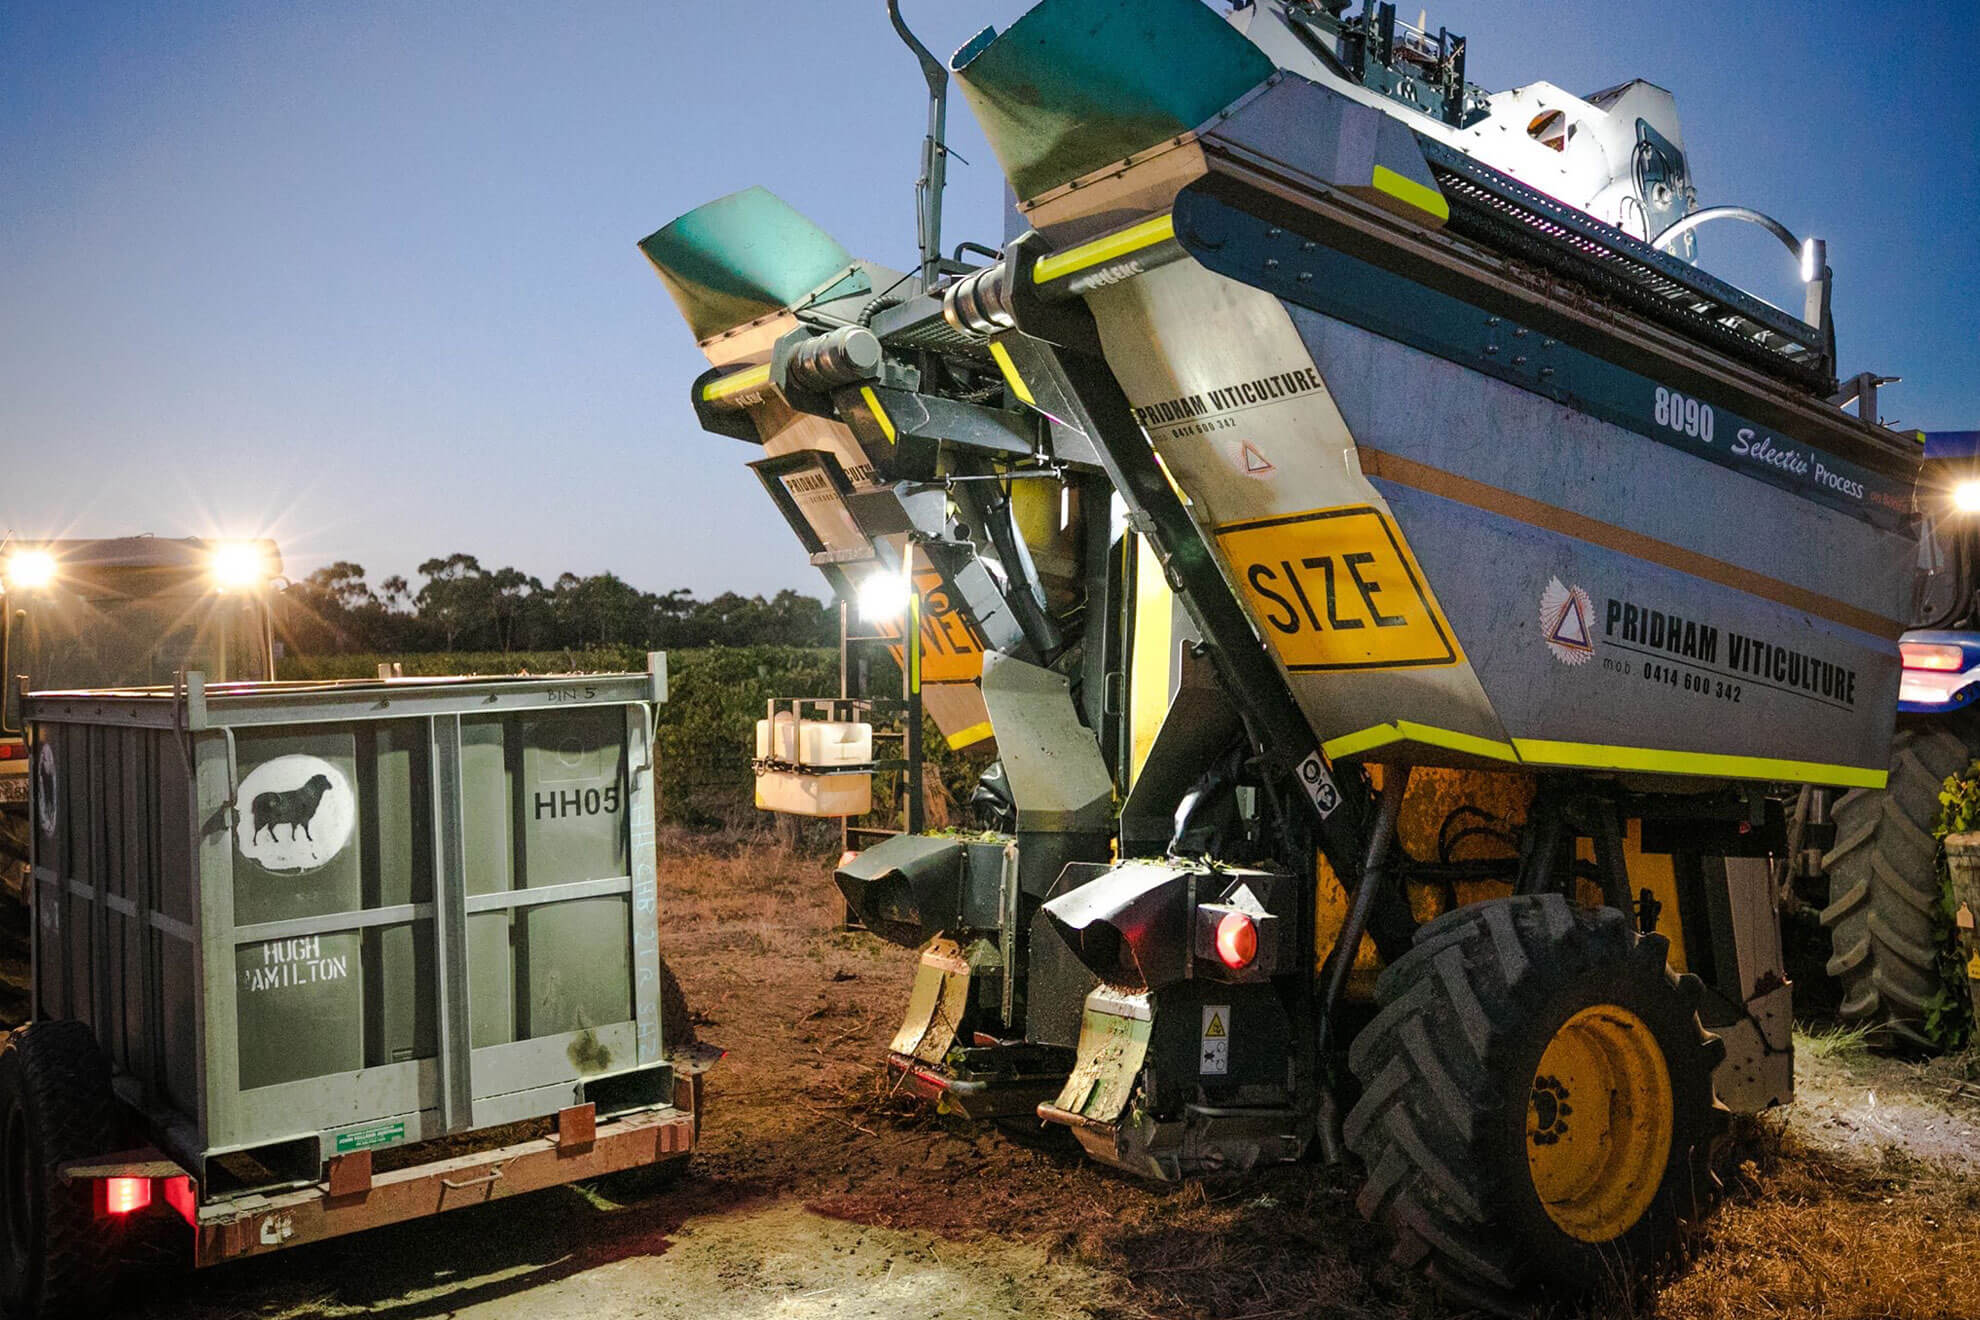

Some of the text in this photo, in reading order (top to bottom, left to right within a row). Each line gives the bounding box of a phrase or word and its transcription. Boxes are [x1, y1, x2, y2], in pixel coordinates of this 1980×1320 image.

[1137, 367, 1321, 426] PRIDHAM VITICULTURE
[1171, 428, 1195, 439] 0414
[1197, 422, 1216, 435] 600
[1217, 417, 1237, 430] 342
[1654, 386, 1715, 443] 8090
[1814, 463, 1864, 500] Process
[1247, 552, 1408, 634] SIZE
[1606, 598, 1857, 705] PRIDHAM VITICULTURE
[547, 687, 597, 702] BIN 5
[1643, 662, 1678, 687] 0414
[1684, 673, 1710, 696] 600
[1715, 682, 1742, 704] 342
[534, 786, 622, 820] HH05
[263, 935, 320, 965] HUGH
[244, 955, 347, 992] AMILTON
